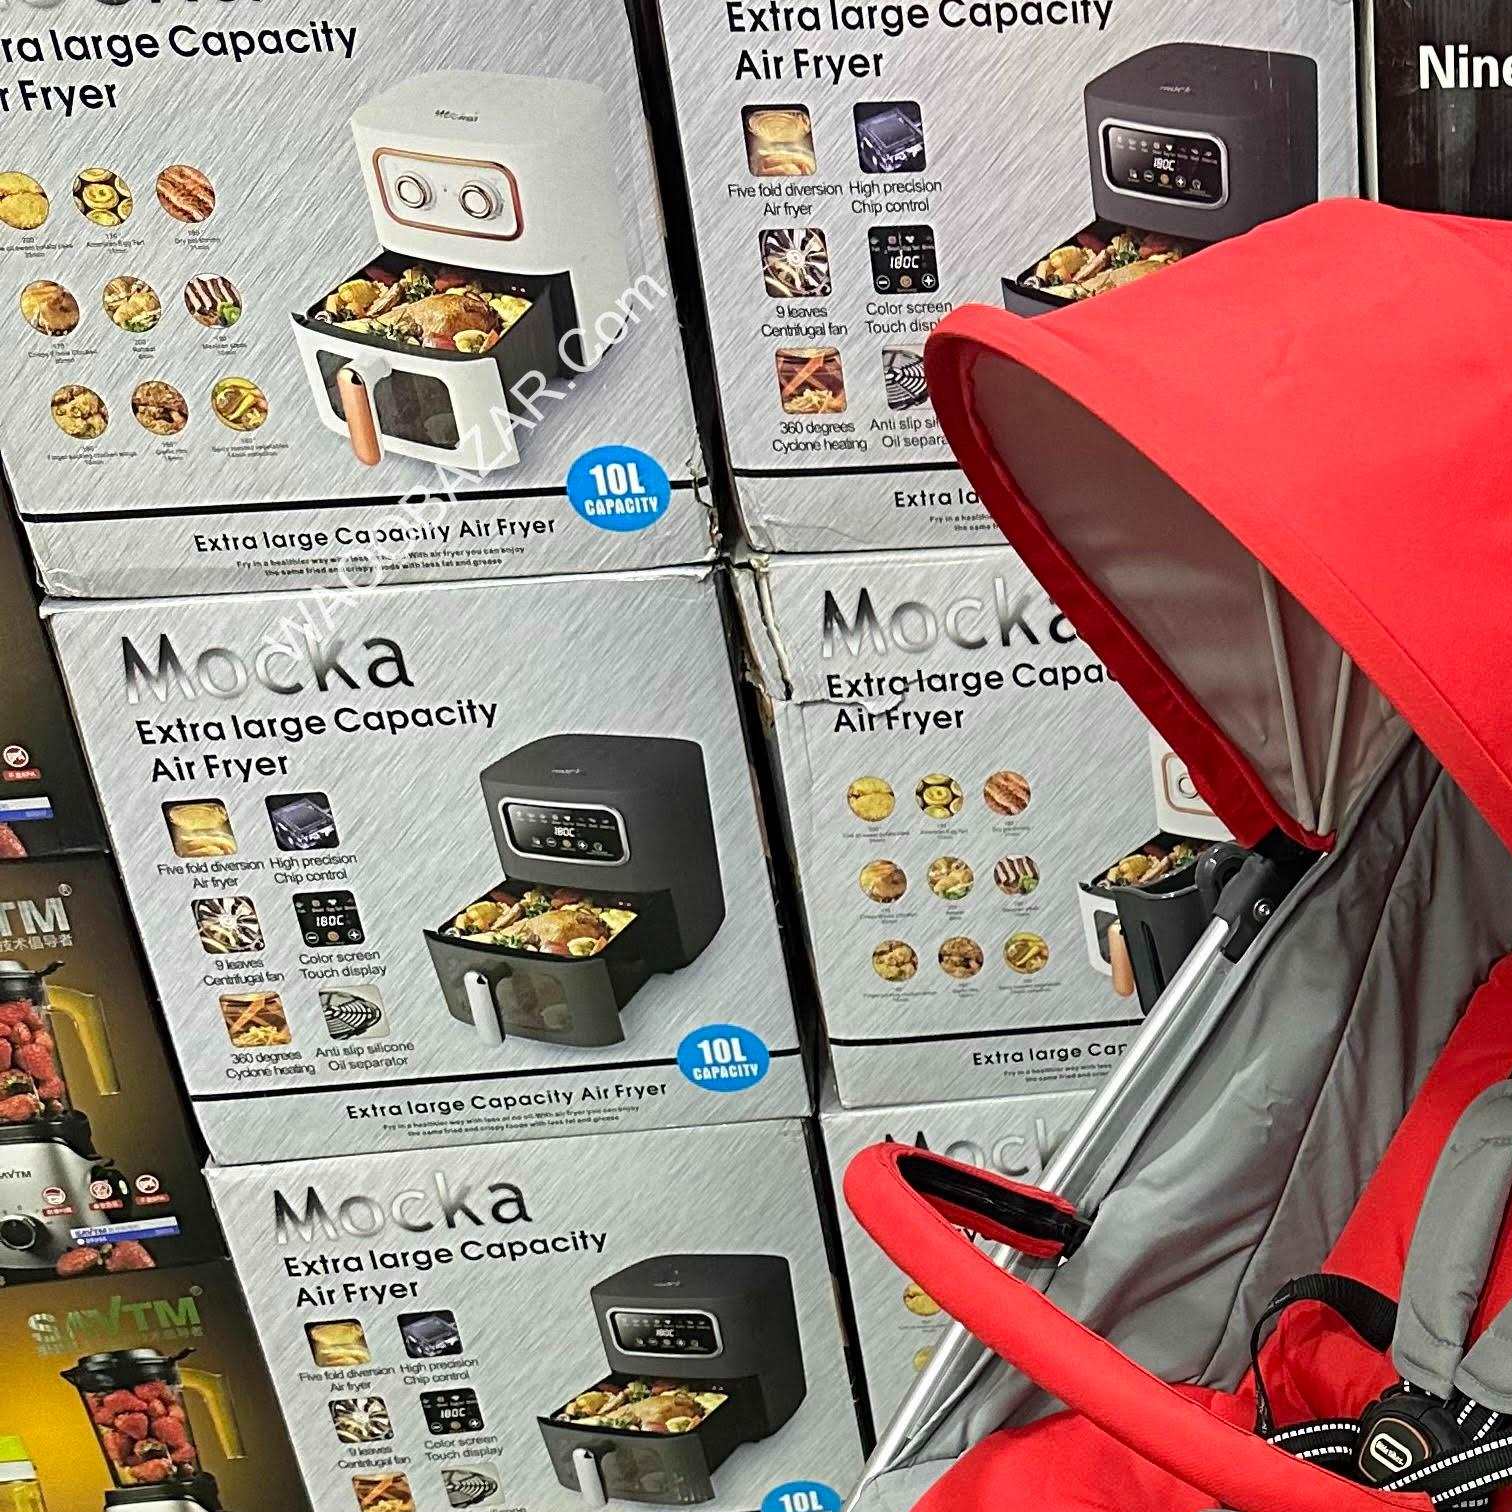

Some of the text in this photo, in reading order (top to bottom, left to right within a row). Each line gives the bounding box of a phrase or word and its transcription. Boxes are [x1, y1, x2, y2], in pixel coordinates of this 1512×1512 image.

[726, 0, 1113, 37] Extra large Capacity
[49, 20, 357, 68] large Capacity
[735, 48, 884, 85] Air Fryer
[17, 79, 117, 117] Fryer
[727, 181, 844, 198] Five fold diversion
[849, 178, 943, 197] High precision
[763, 201, 813, 219] Air fryer
[851, 197, 930, 217] Chip control
[776, 304, 828, 318] 9 leaves
[866, 301, 953, 316] Color screen
[761, 322, 849, 340] Centrifugal fan
[866, 319, 907, 335] Touch
[780, 421, 856, 436] 360 degrees
[870, 417, 922, 432] Anti slip
[772, 437, 868, 454] Cyclone heating
[882, 435, 901, 448] Oil
[589, 461, 647, 497] 10L
[584, 496, 658, 517] CAPACITY
[893, 489, 952, 508] Extra
[193, 531, 258, 554] Extra
[263, 530, 329, 550] large
[459, 517, 491, 538] Air
[497, 516, 556, 539] Fryer
[120, 632, 415, 705] Mocka
[826, 671, 911, 699] Extra
[916, 669, 1004, 698] large
[136, 699, 498, 745] Extra large Capacity
[834, 706, 964, 735] Air Fryer
[151, 754, 288, 783] Air Fryer
[157, 859, 265, 876] Five fold diversion
[269, 854, 358, 871] High precision
[193, 876, 239, 890] Air fryer
[274, 869, 348, 886] Chip control
[298, 950, 381, 966] Color screen
[299, 965, 387, 980] Touch display
[315, 1046, 341, 1059] Anti
[367, 1041, 415, 1054] silicone
[697, 1037, 748, 1065] 10L
[973, 1050, 1024, 1066] Extra
[1029, 1047, 1082, 1062] large
[328, 1056, 410, 1072] Oil separator
[692, 1063, 759, 1081] CAPACITY
[346, 1082, 668, 1120] Extra large Capacity Air Fryer
[273, 1170, 533, 1245] Mocka
[283, 1229, 607, 1278] Extra large Capacity
[296, 1279, 418, 1308] Air Fryer
[400, 1362, 427, 1376] High
[433, 1371, 470, 1384] control
[425, 1450, 461, 1462] Touch
[779, 1490, 824, 1512] 10L
